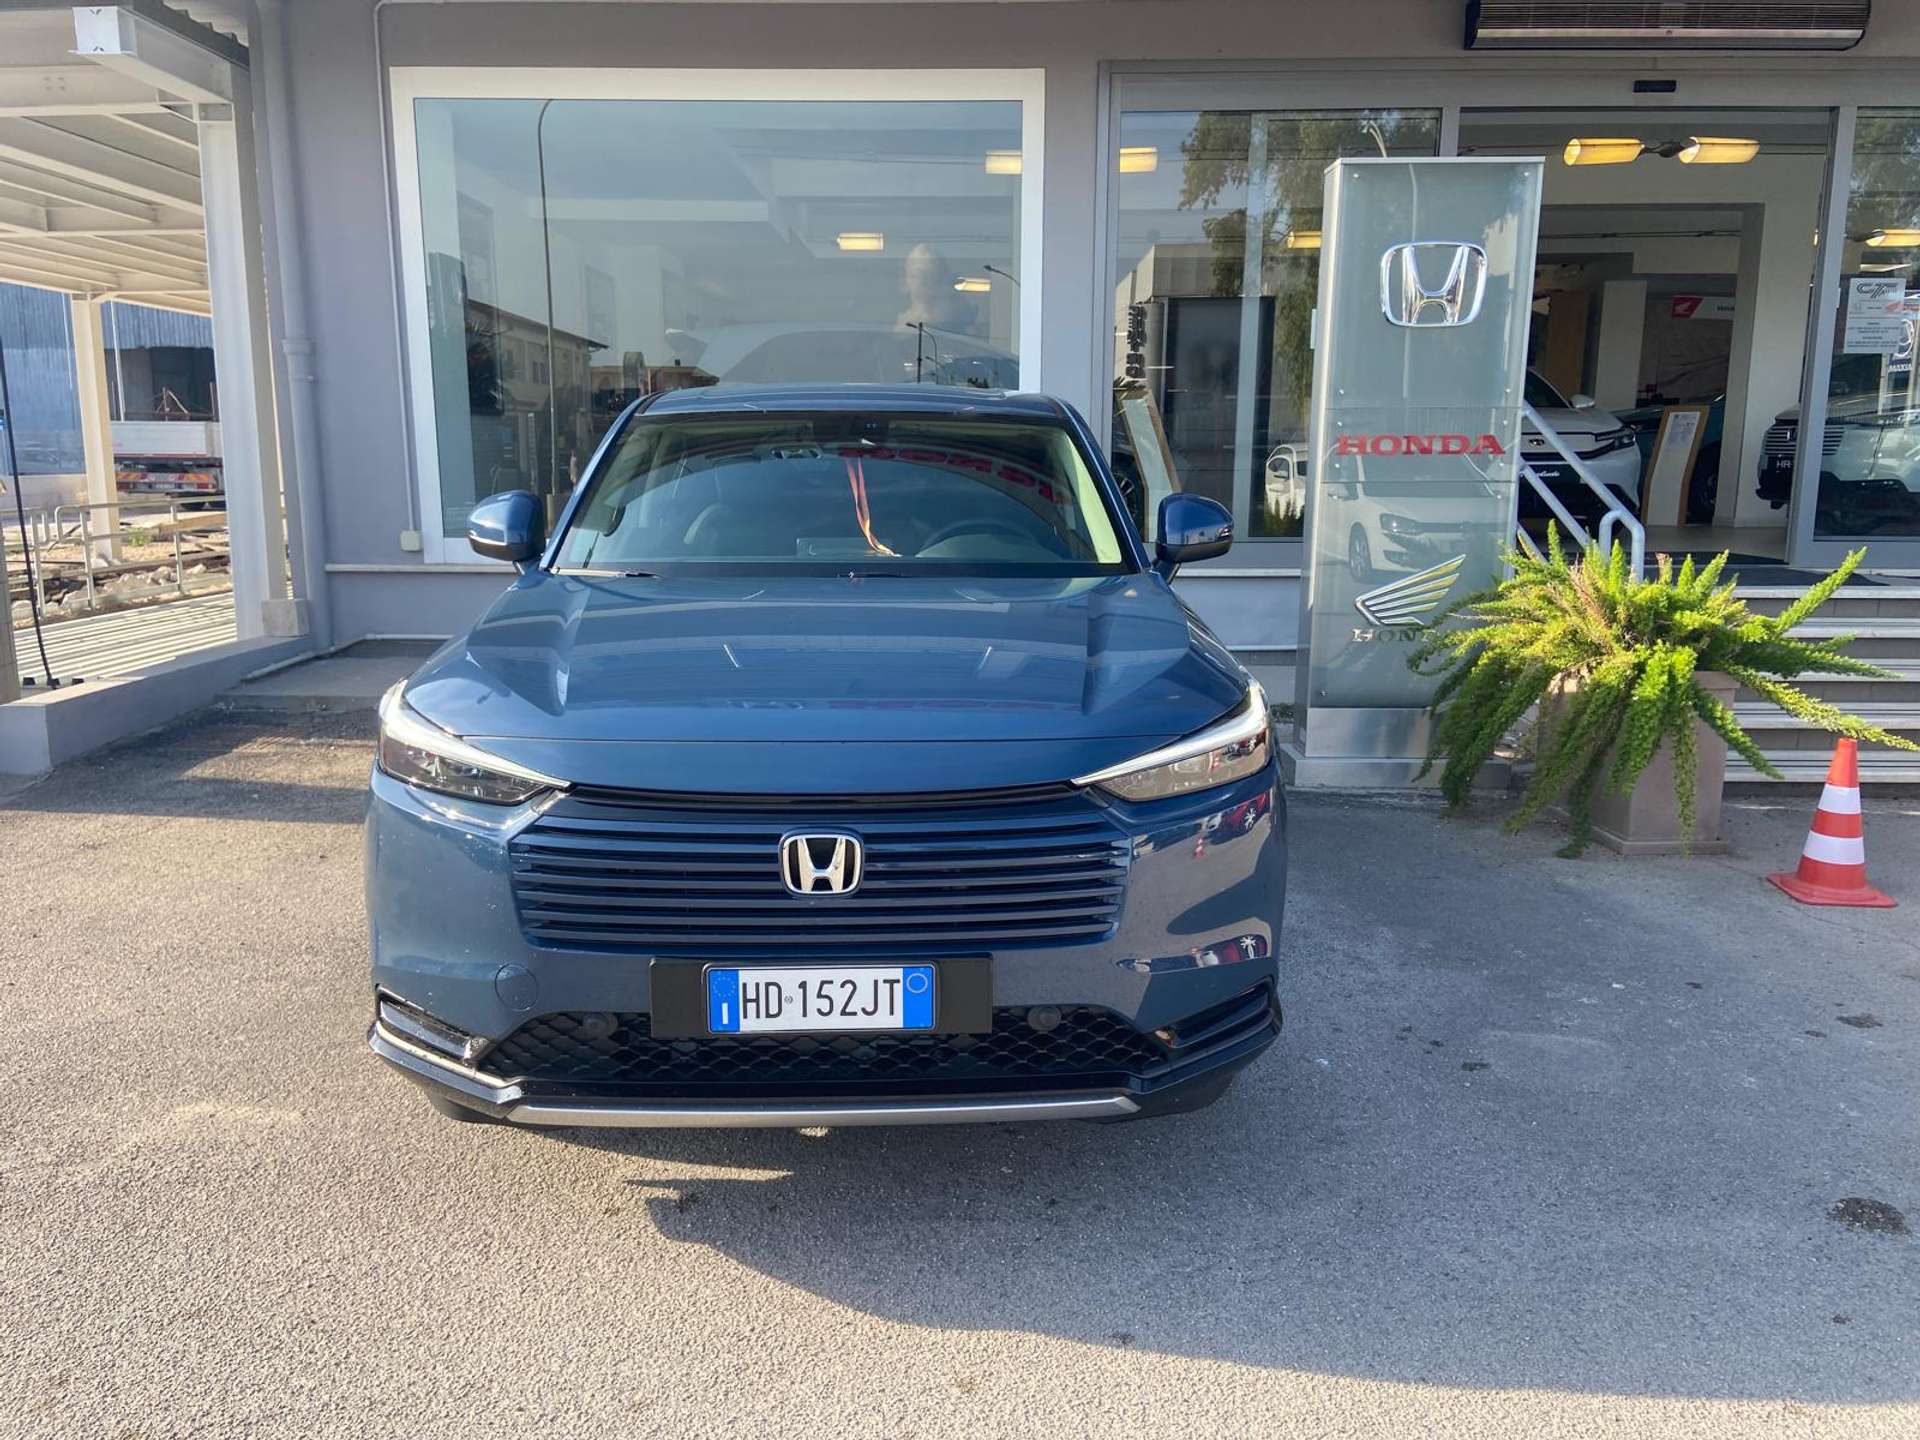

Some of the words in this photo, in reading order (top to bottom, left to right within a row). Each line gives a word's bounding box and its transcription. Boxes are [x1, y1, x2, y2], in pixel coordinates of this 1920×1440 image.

[1336, 434, 1505, 456] HONDA
[742, 981, 783, 1019] HD
[798, 979, 901, 1017] 152JT
